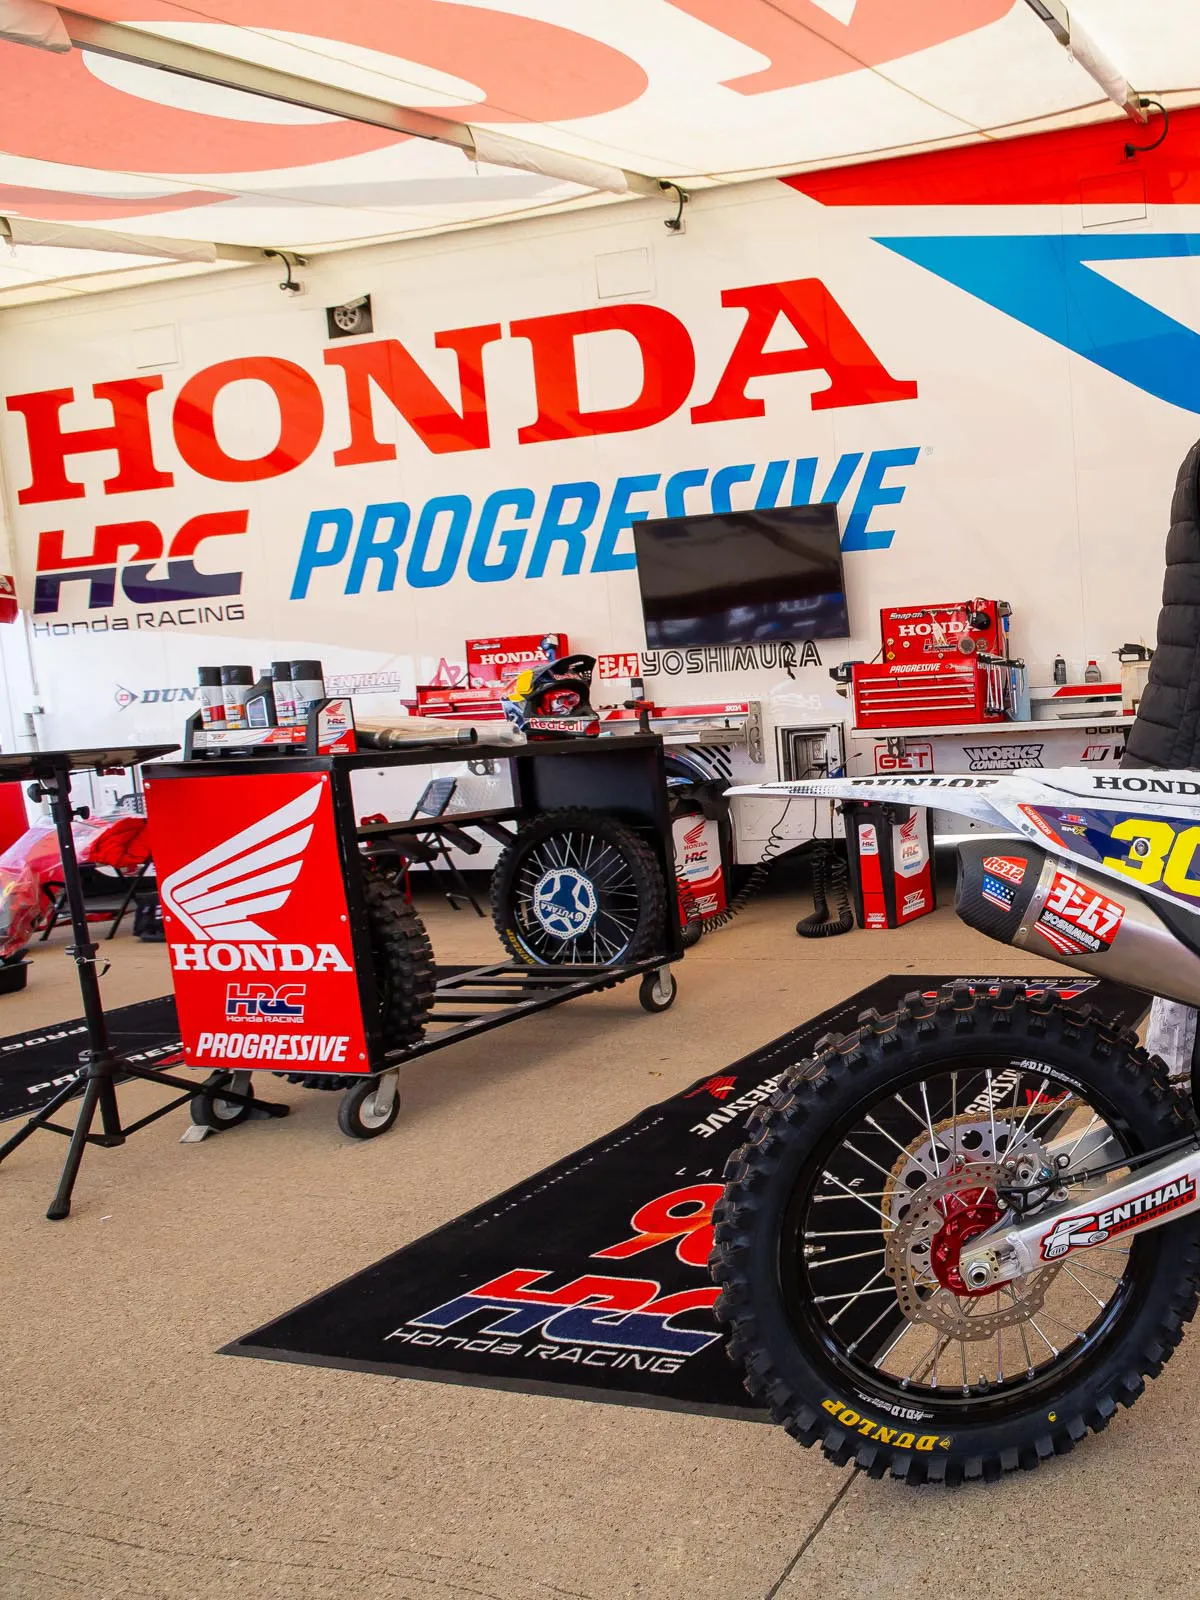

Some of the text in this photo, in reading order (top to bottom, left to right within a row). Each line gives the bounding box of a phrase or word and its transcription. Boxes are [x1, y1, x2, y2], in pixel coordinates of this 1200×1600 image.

[5, 277, 918, 505] HONDA
[33, 509, 249, 614] HRC
[34, 604, 245, 638] Honda RACING
[480, 649, 548, 665] HONDA
[641, 640, 823, 676] YOSHIMURA
[889, 662, 941, 674] PROGRESSIVE
[530, 718, 584, 732] Red Bull
[879, 751, 929, 770] GET
[966, 745, 1043, 760] WORKS
[969, 757, 1043, 771] CONNECTION
[984, 857, 1025, 881] RS12
[1041, 910, 1101, 950] YOSHIMURA
[170, 943, 352, 972] HONDA
[226, 983, 306, 1016] HRC
[264, 1016, 304, 1024] RACING
[196, 1032, 349, 1062] PROGRESSIVE
[1043, 1176, 1195, 1259] RENTHAL
[406, 1268, 723, 1357] HRC
[383, 1327, 685, 1374] Honda RACING
[821, 1398, 940, 1452] DUNLOP
